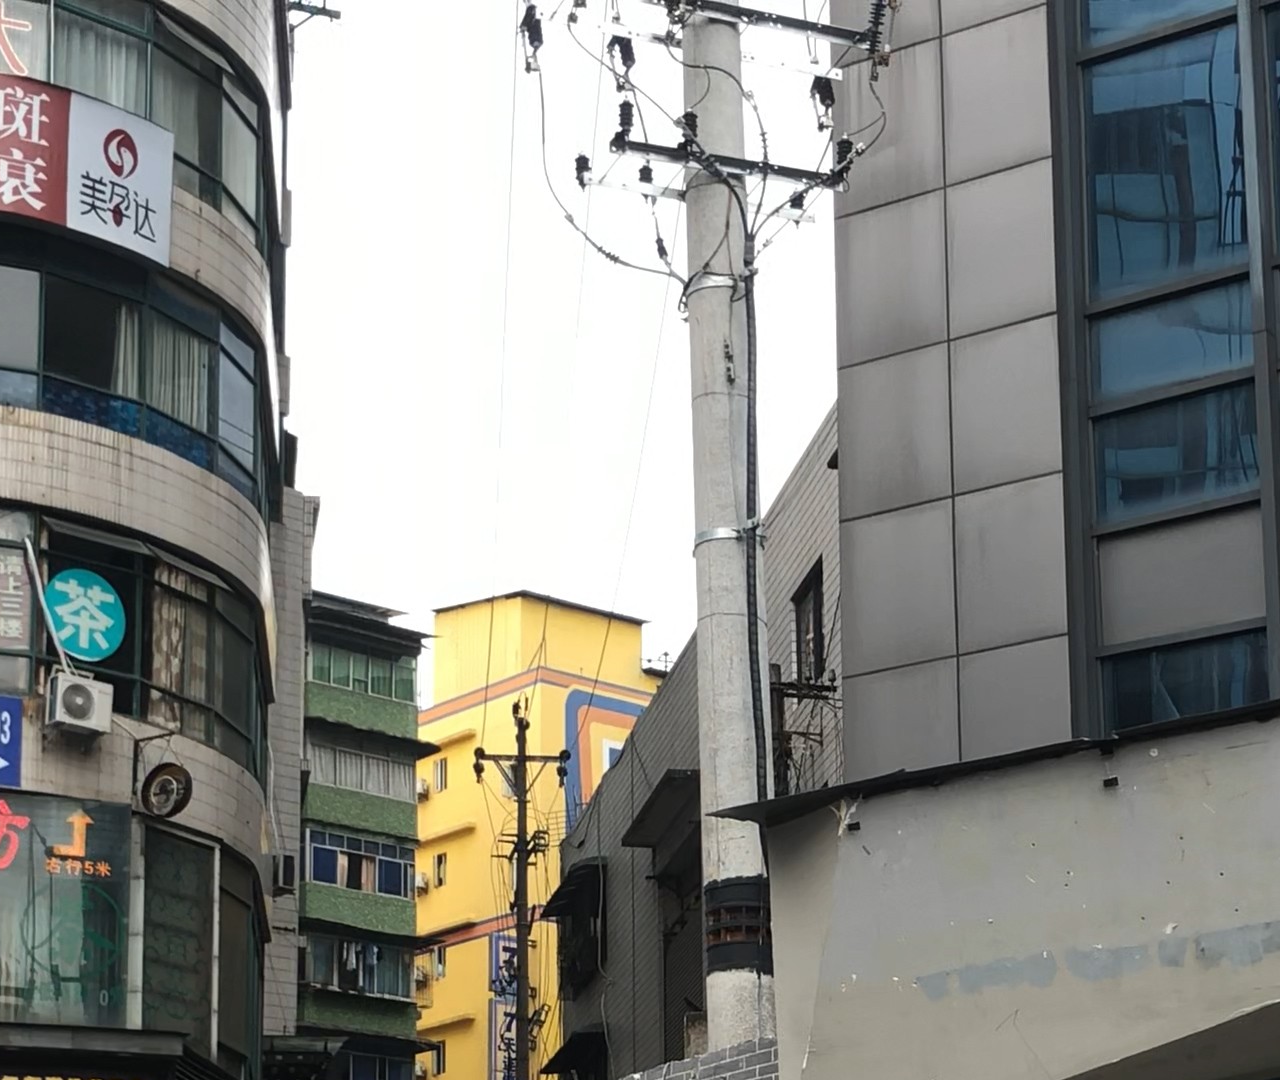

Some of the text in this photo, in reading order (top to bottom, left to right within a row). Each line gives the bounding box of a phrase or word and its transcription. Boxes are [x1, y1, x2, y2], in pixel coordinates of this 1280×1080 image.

[78, 169, 158, 244] 美孕达
[53, 578, 115, 650] 茶
